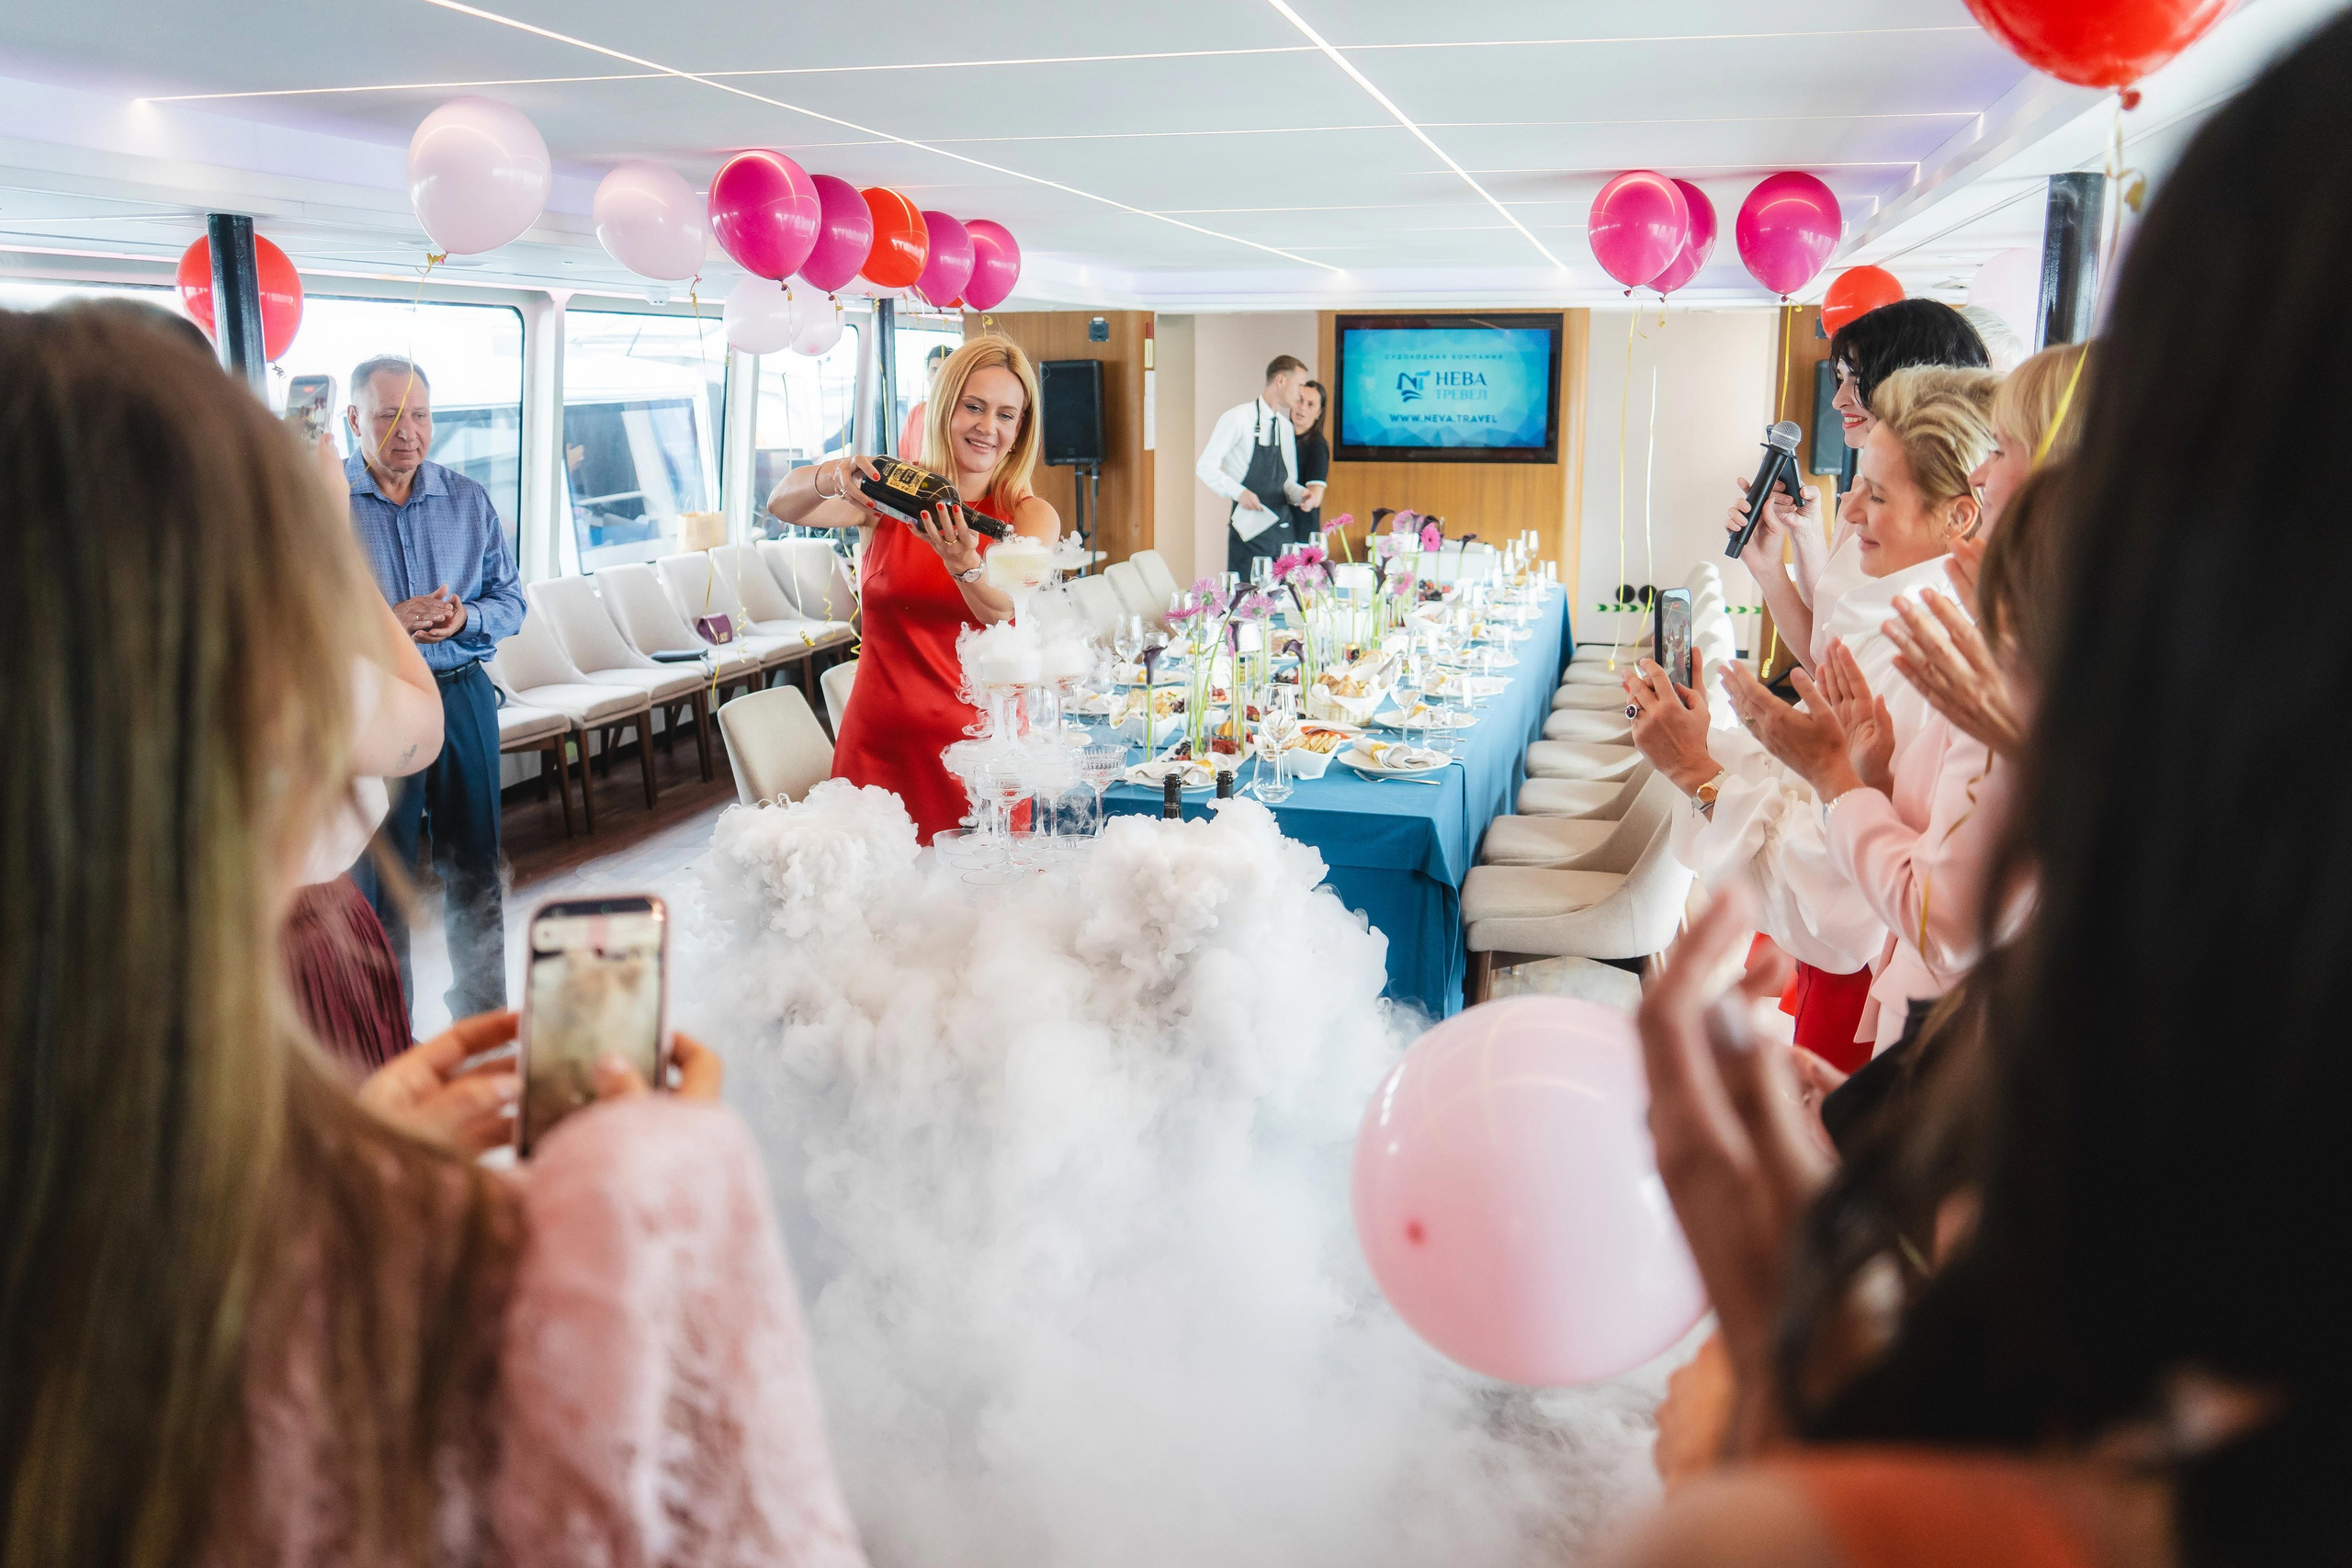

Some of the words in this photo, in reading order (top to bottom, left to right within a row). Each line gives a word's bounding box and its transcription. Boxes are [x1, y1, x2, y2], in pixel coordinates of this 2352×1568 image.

[1436, 371, 1487, 386] НЕВА
[1436, 389, 1487, 400] ТРЕВЕЛ
[1389, 413, 1498, 423] WWW.NEVA.TRAVEL
